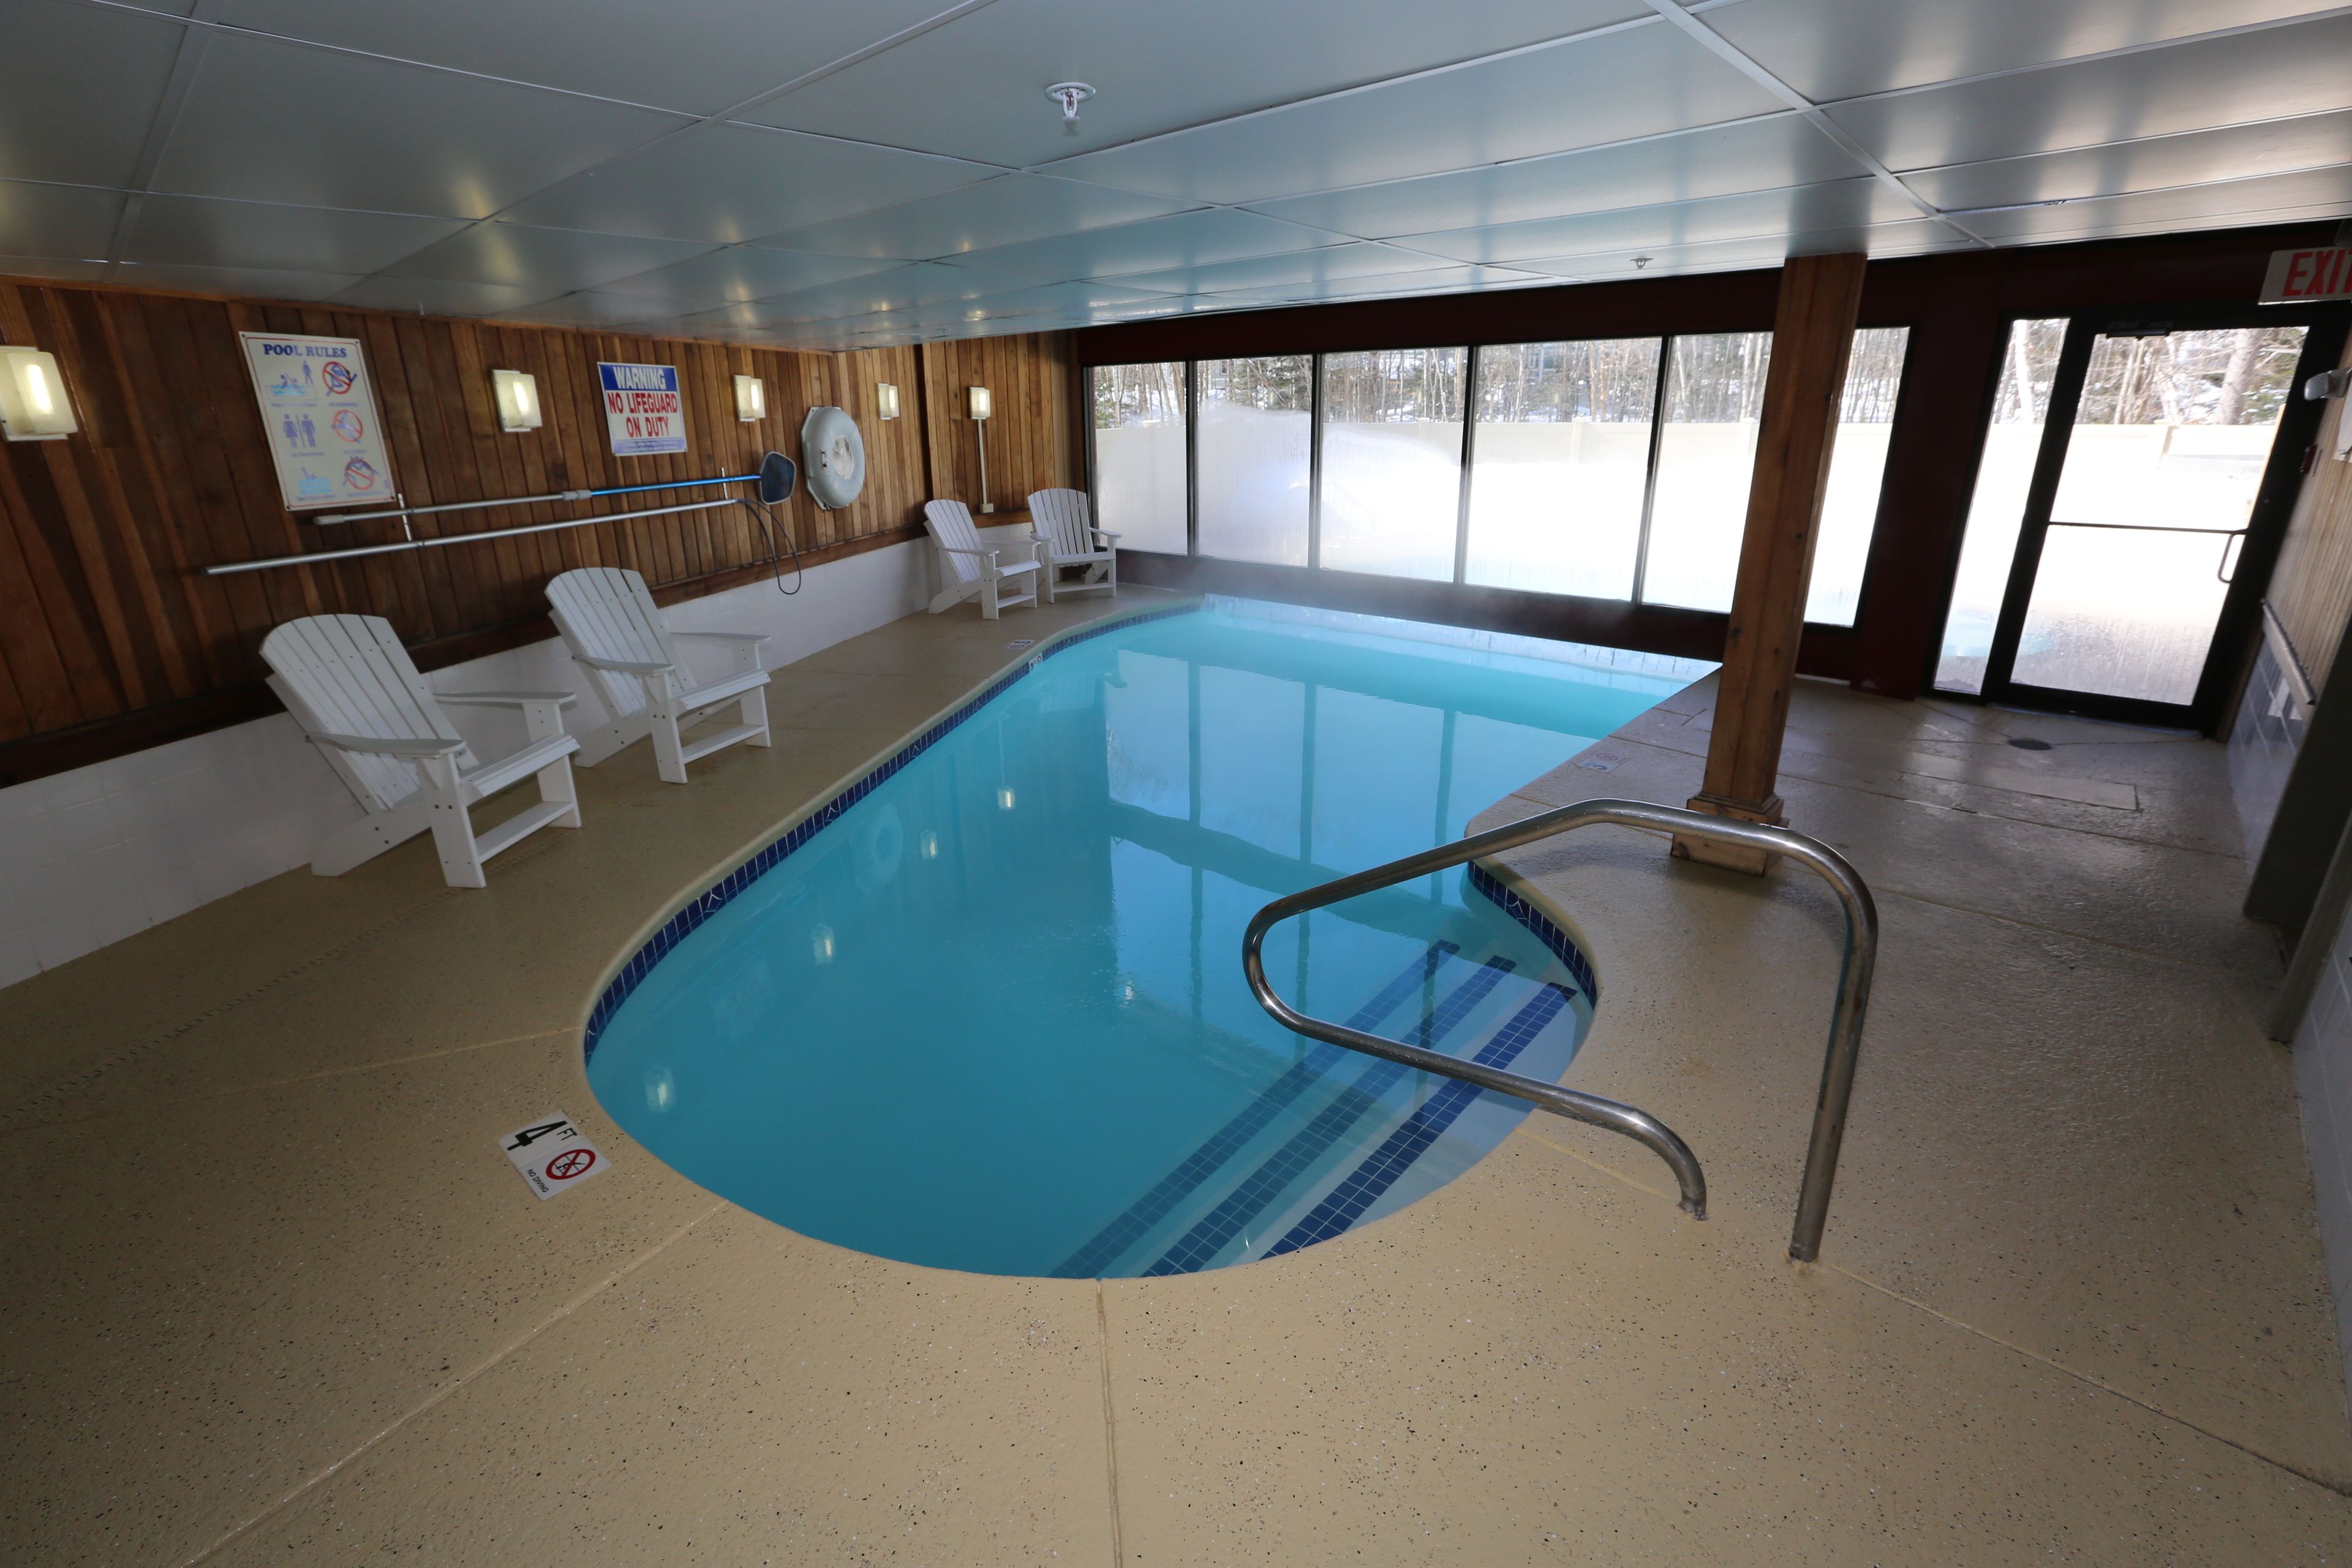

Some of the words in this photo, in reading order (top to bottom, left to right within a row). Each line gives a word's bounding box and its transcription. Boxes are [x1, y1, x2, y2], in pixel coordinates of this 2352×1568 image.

[263, 344, 303, 356] POOL
[305, 345, 347, 358] RULES
[613, 367, 666, 390] WARNING
[608, 393, 624, 413] NO
[626, 393, 678, 413] LIFEGUARD
[626, 417, 641, 437] ON
[645, 417, 669, 437] DUTY
[507, 1120, 568, 1151] 4
[557, 1128, 578, 1140] FT
[533, 1176, 549, 1193] DIVING
